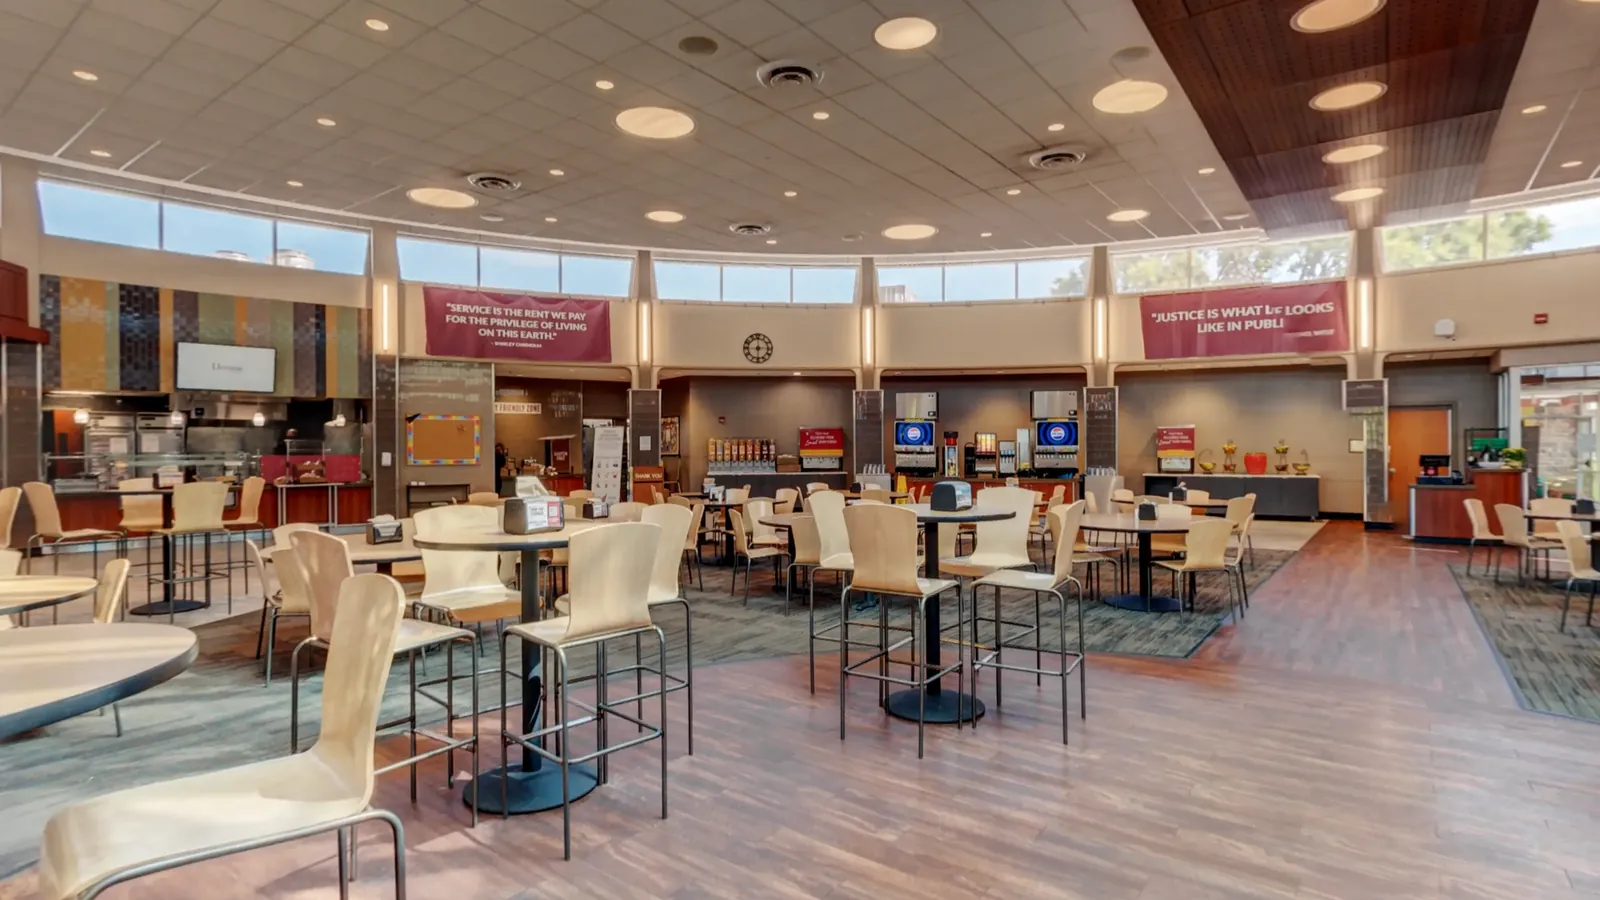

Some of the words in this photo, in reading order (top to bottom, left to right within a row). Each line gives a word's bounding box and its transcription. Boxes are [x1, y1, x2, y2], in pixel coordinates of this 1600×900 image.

[446, 303, 491, 314] "SERVICE
[493, 306, 502, 315] IS
[503, 307, 523, 317] THE
[524, 308, 549, 319] RENT
[551, 310, 567, 320] WE
[568, 311, 586, 321] PAY
[1151, 309, 1205, 323] "JUSTICE
[1207, 308, 1219, 319] IS
[1221, 305, 1264, 319] WHAT
[1285, 301, 1335, 316] LOOKS
[445, 314, 467, 324] FOR
[468, 316, 489, 326] THE
[490, 317, 539, 329] PRIVILEGE
[540, 321, 554, 330] OF
[555, 321, 587, 332] LIVING
[1197, 321, 1225, 334] LIKE
[1227, 320, 1242, 332] IN
[478, 327, 494, 337] ON
[496, 328, 519, 339] THIS
[520, 329, 557, 341] EARTH."
[499, 404, 525, 412] FRIENDLY
[526, 404, 540, 413] ZONE
